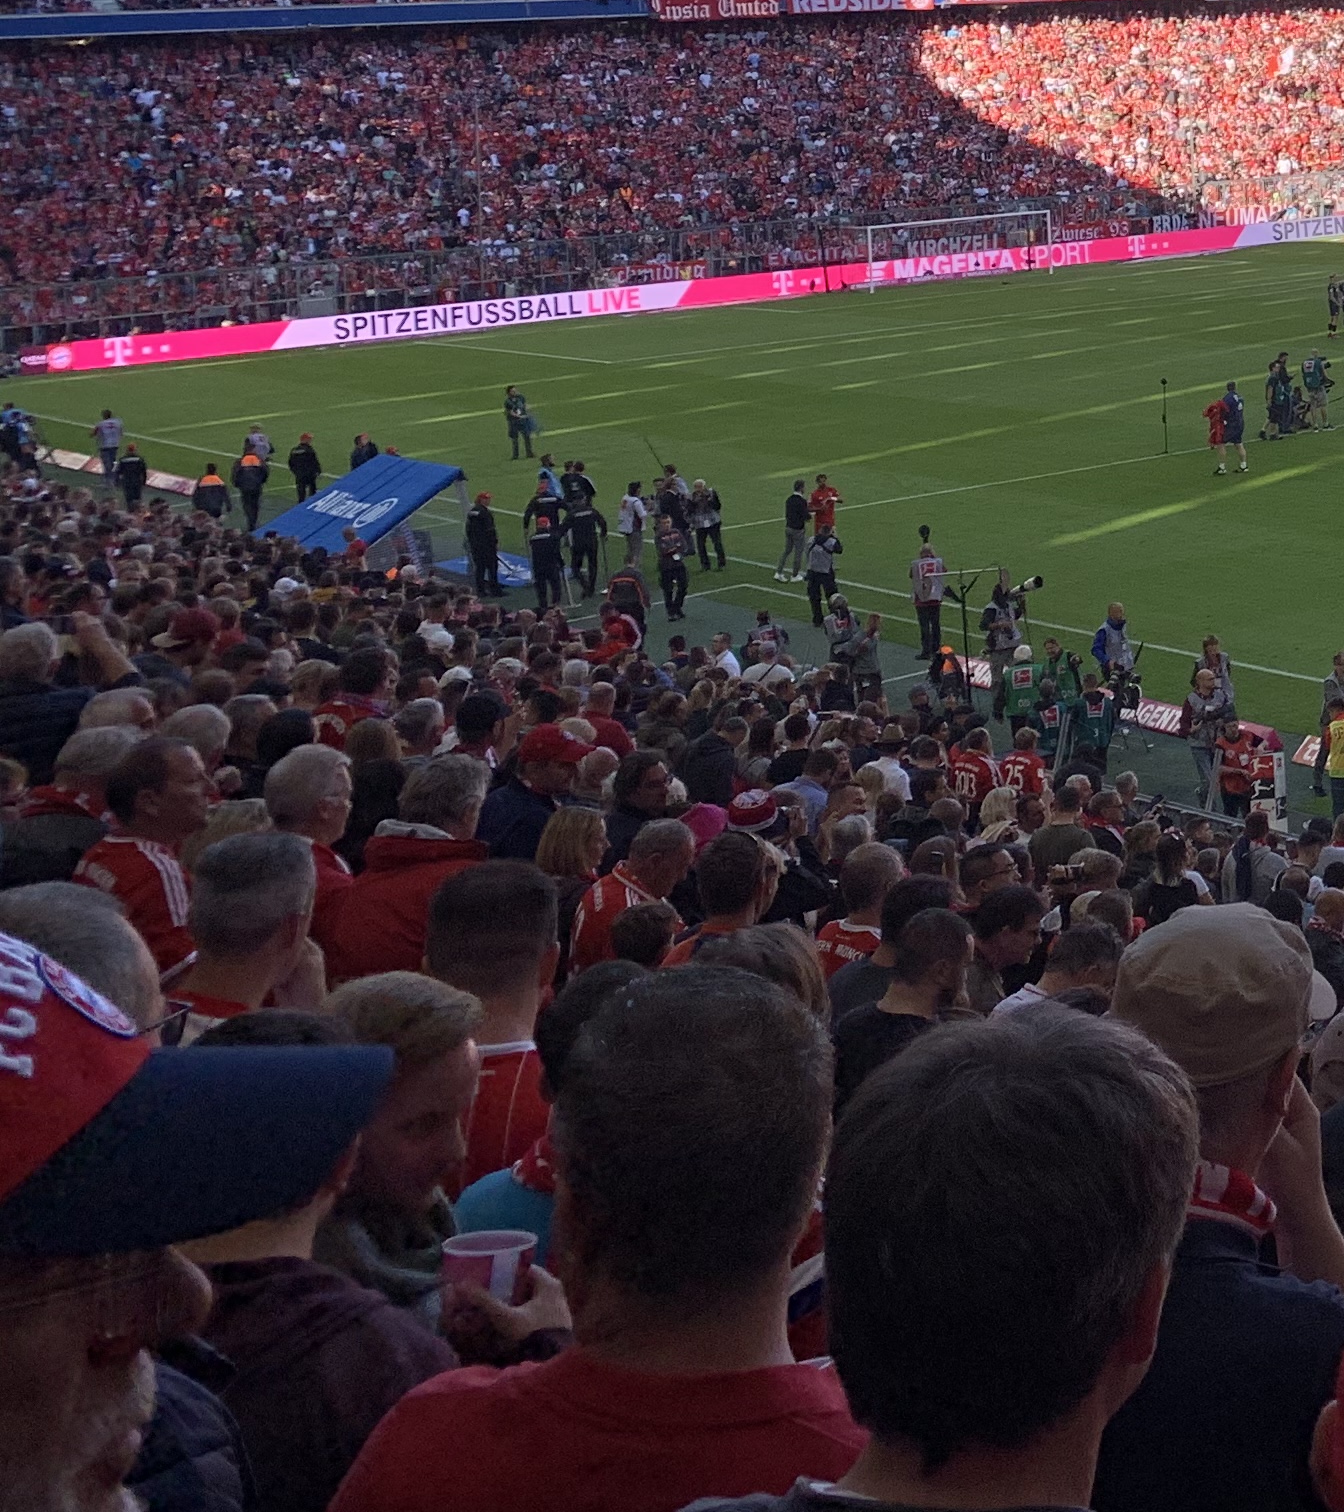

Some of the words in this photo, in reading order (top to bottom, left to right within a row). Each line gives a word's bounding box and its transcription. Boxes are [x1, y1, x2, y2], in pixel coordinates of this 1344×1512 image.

[894, 249, 1014, 279] MAGENTA
[1020, 240, 1093, 268] SPORT
[907, 233, 1002, 257] KIRCHZELL
[334, 294, 583, 340] SPITZENFUSSBALL
[587, 288, 641, 313] LIVE
[306, 488, 371, 519] Allianz
[1004, 763, 1024, 791] 25
